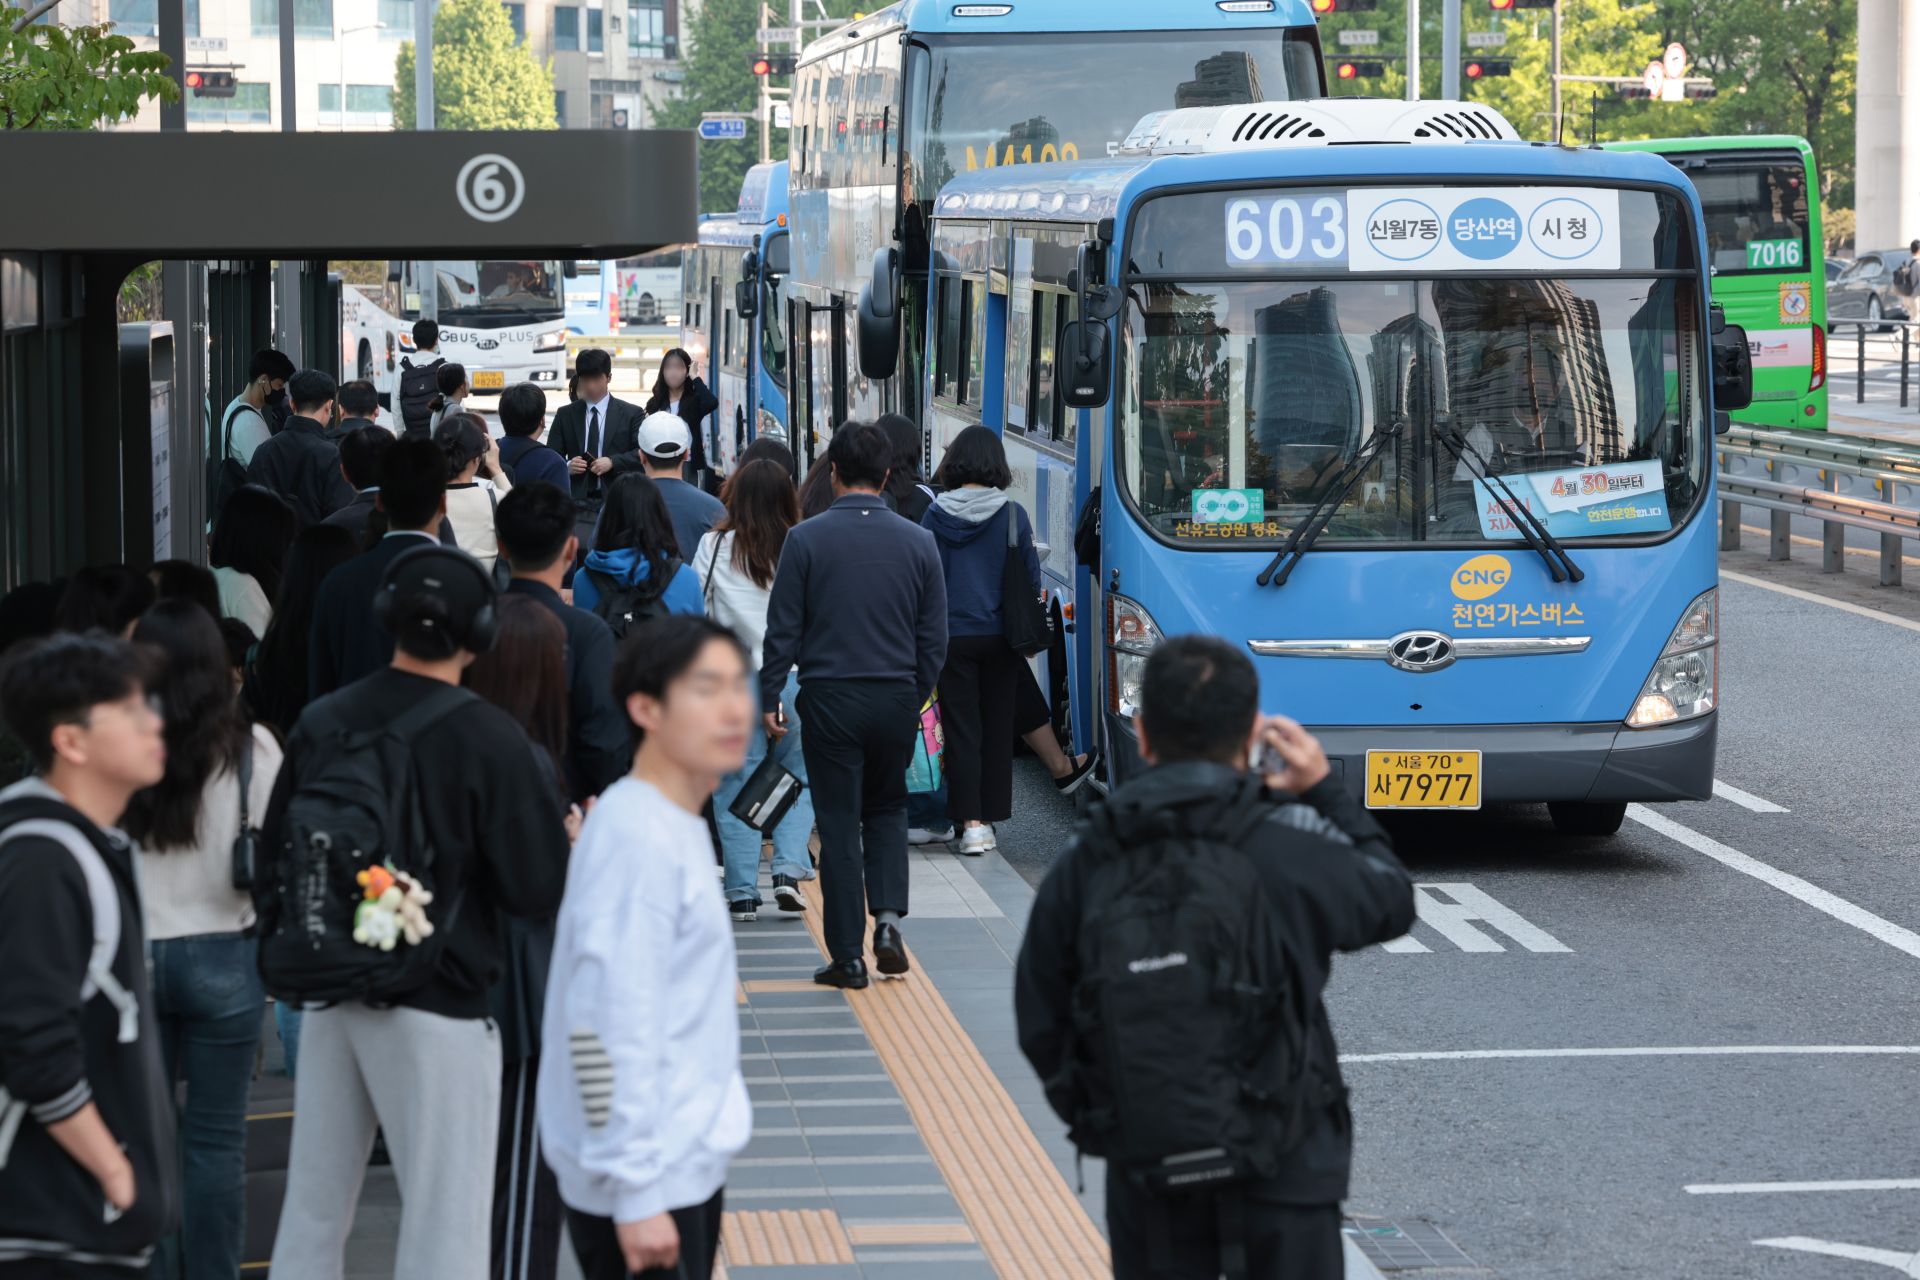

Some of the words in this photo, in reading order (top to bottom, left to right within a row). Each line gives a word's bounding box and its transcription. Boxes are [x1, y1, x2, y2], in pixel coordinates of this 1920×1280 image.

[1227, 197, 1346, 260] 603
[1369, 218, 1439, 241] 신월7동
[1453, 216, 1517, 242] 당산역
[1749, 240, 1800, 267] 7016
[499, 331, 534, 343] PLUS
[1551, 475, 1578, 498] 4월
[1580, 471, 1644, 495] 30일부터
[1175, 521, 1248, 538] 선유도공원
[1457, 569, 1506, 586] CNG
[1452, 602, 1585, 629] 천연가스버스
[1395, 755, 1422, 769] 서울
[1427, 755, 1452, 769] 70
